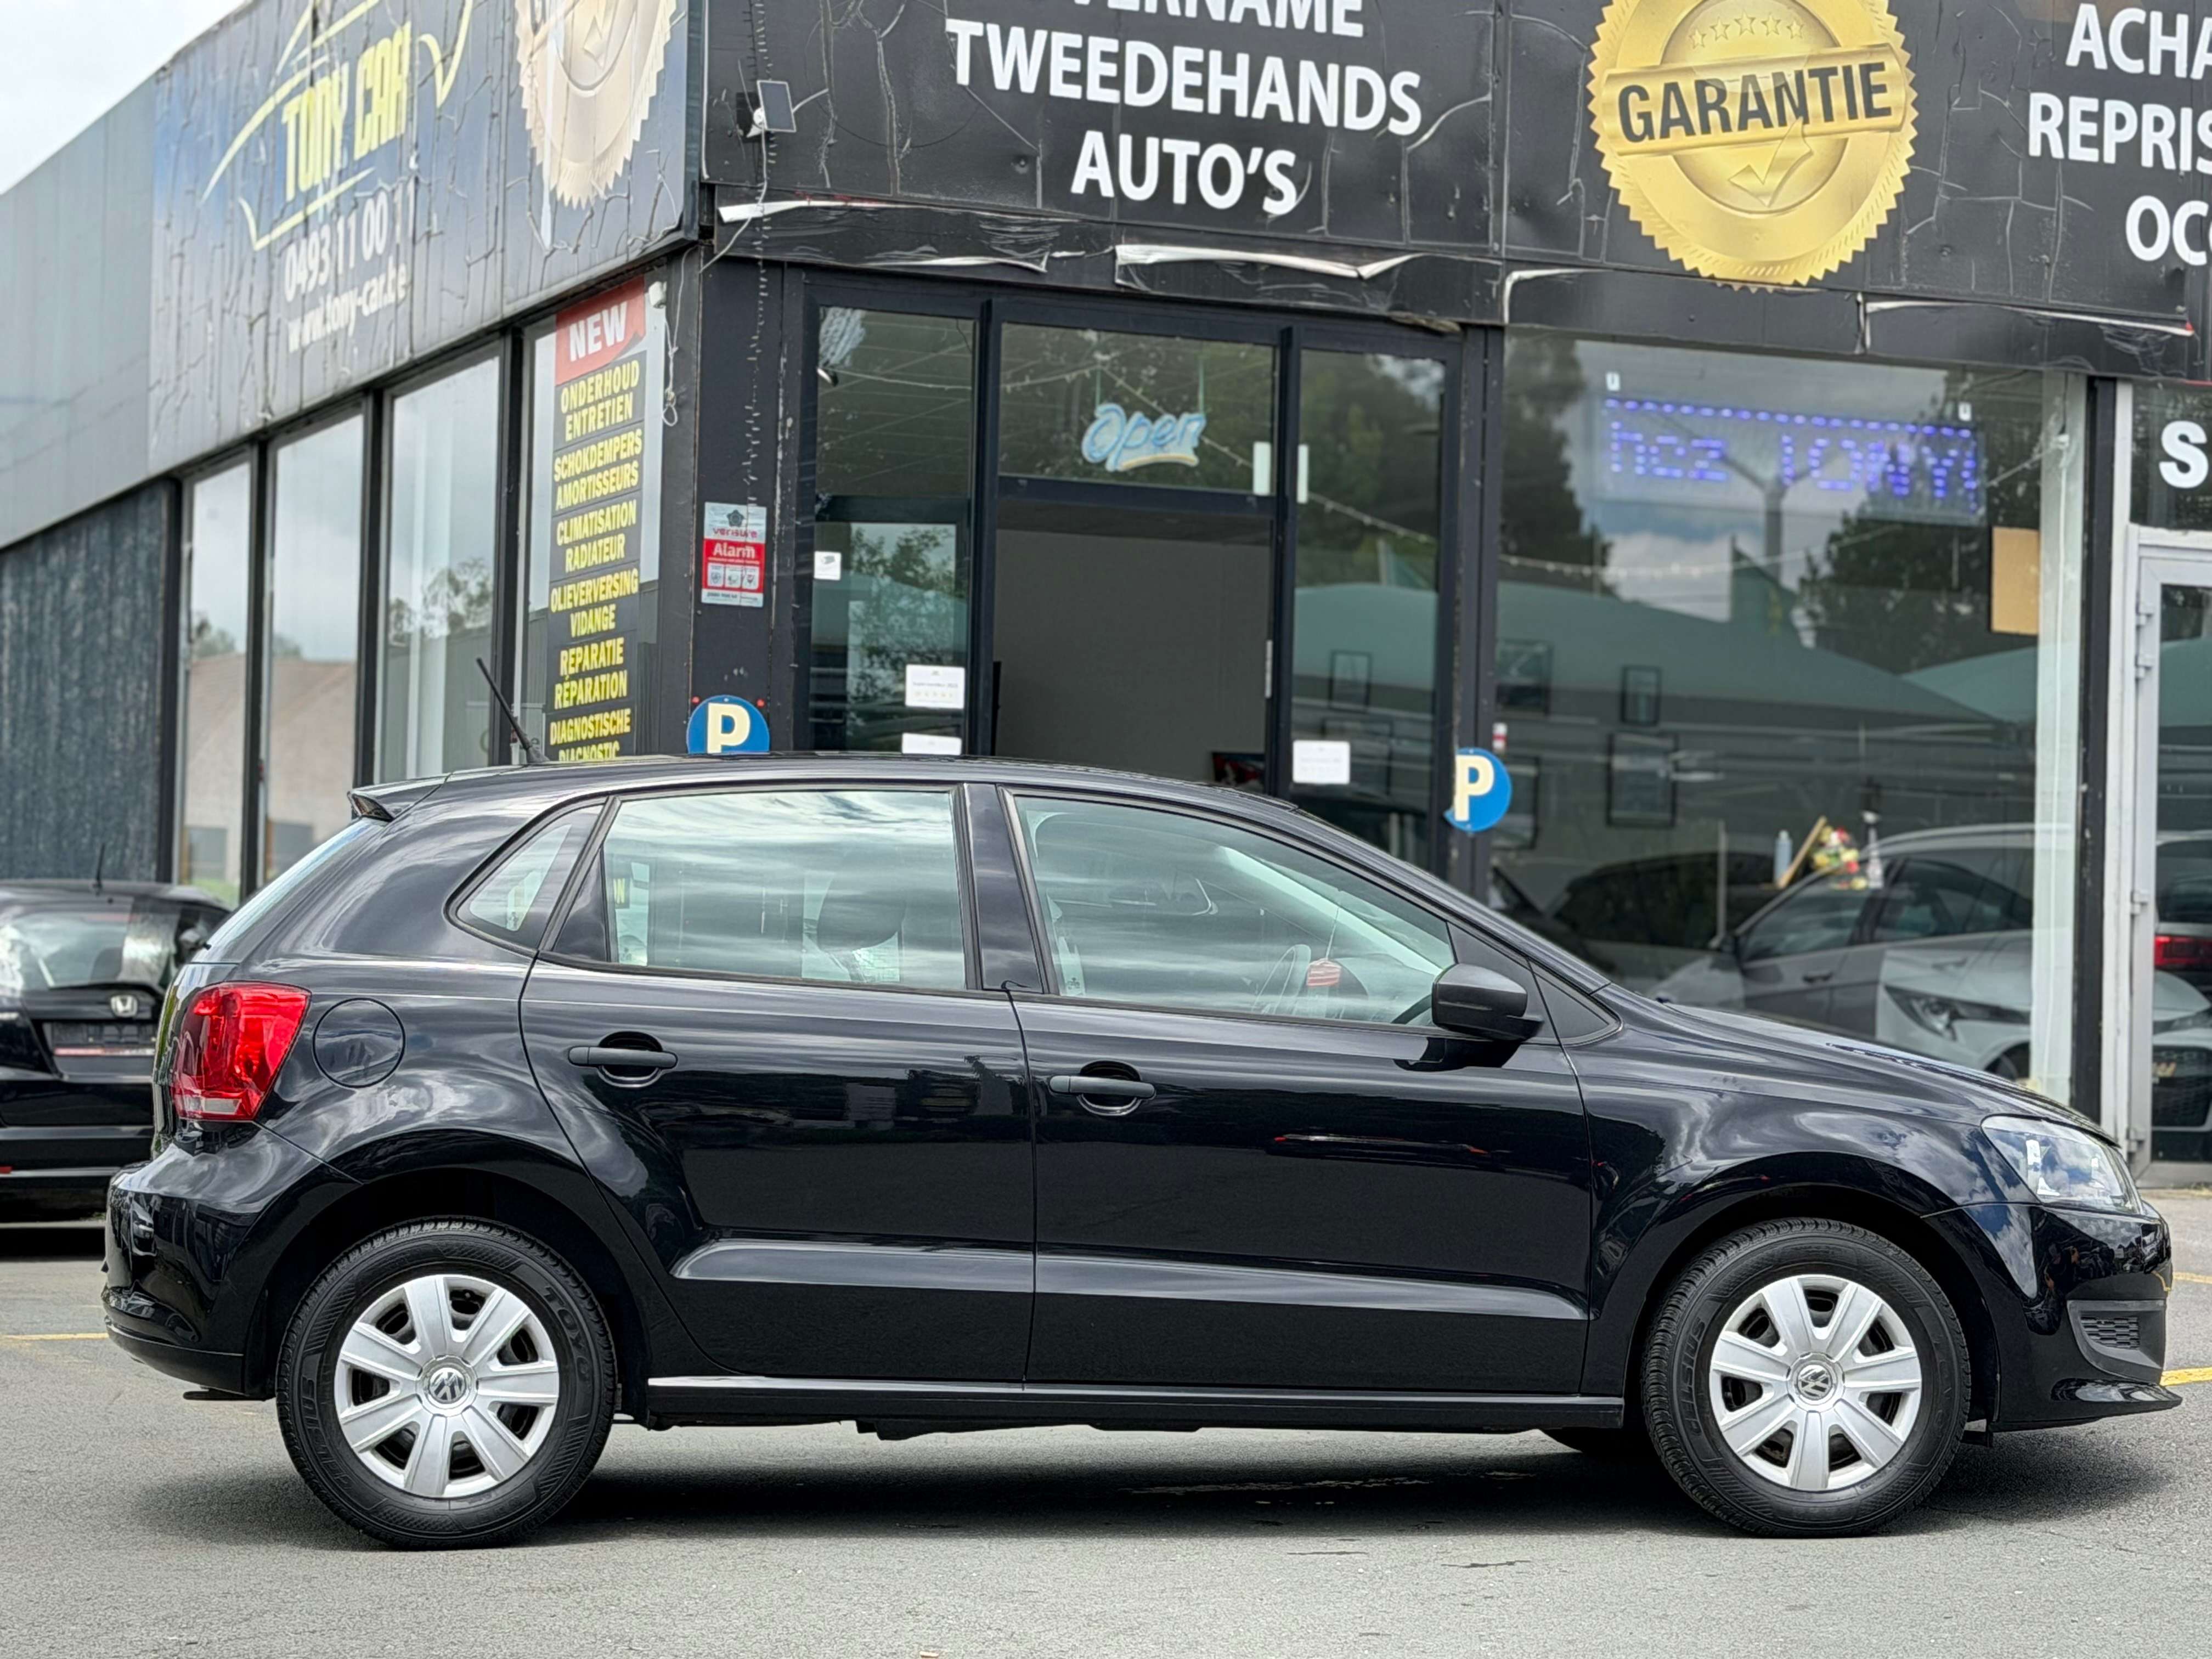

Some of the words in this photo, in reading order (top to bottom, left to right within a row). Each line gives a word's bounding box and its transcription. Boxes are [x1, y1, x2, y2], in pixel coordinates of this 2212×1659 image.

[946, 18, 1421, 137] TWEEDEHANDS
[1617, 62, 1893, 143] GARANTIE
[281, 61, 349, 201] TONY
[354, 20, 411, 160] CAR
[1070, 130, 1297, 216] AUTO'S
[285, 223, 330, 302] 0493
[337, 212, 356, 275] 11
[362, 191, 388, 261] 00
[2125, 195, 2212, 267] OC
[569, 302, 628, 362] NEW
[561, 360, 640, 414] ONDERHOUD
[566, 392, 633, 441] ENTRETIEN
[1081, 402, 1206, 472] Open
[554, 428, 642, 482] SCHOKDEMPERS
[2159, 420, 2209, 489] S
[556, 461, 639, 510] AMORTISSEURS
[557, 500, 636, 546] CLIMATISATION
[566, 534, 625, 573] RADIATEUR
[713, 543, 755, 558] Alarm
[551, 568, 639, 613] OLIEVERVERSING
[571, 604, 616, 639] VIDANGE
[560, 637, 625, 676] REPARATIE
[554, 669, 628, 710] RÉPARATION
[550, 708, 631, 746] DIAGNOSTISCHE
[707, 703, 751, 754] P
[1454, 755, 1495, 822] P
